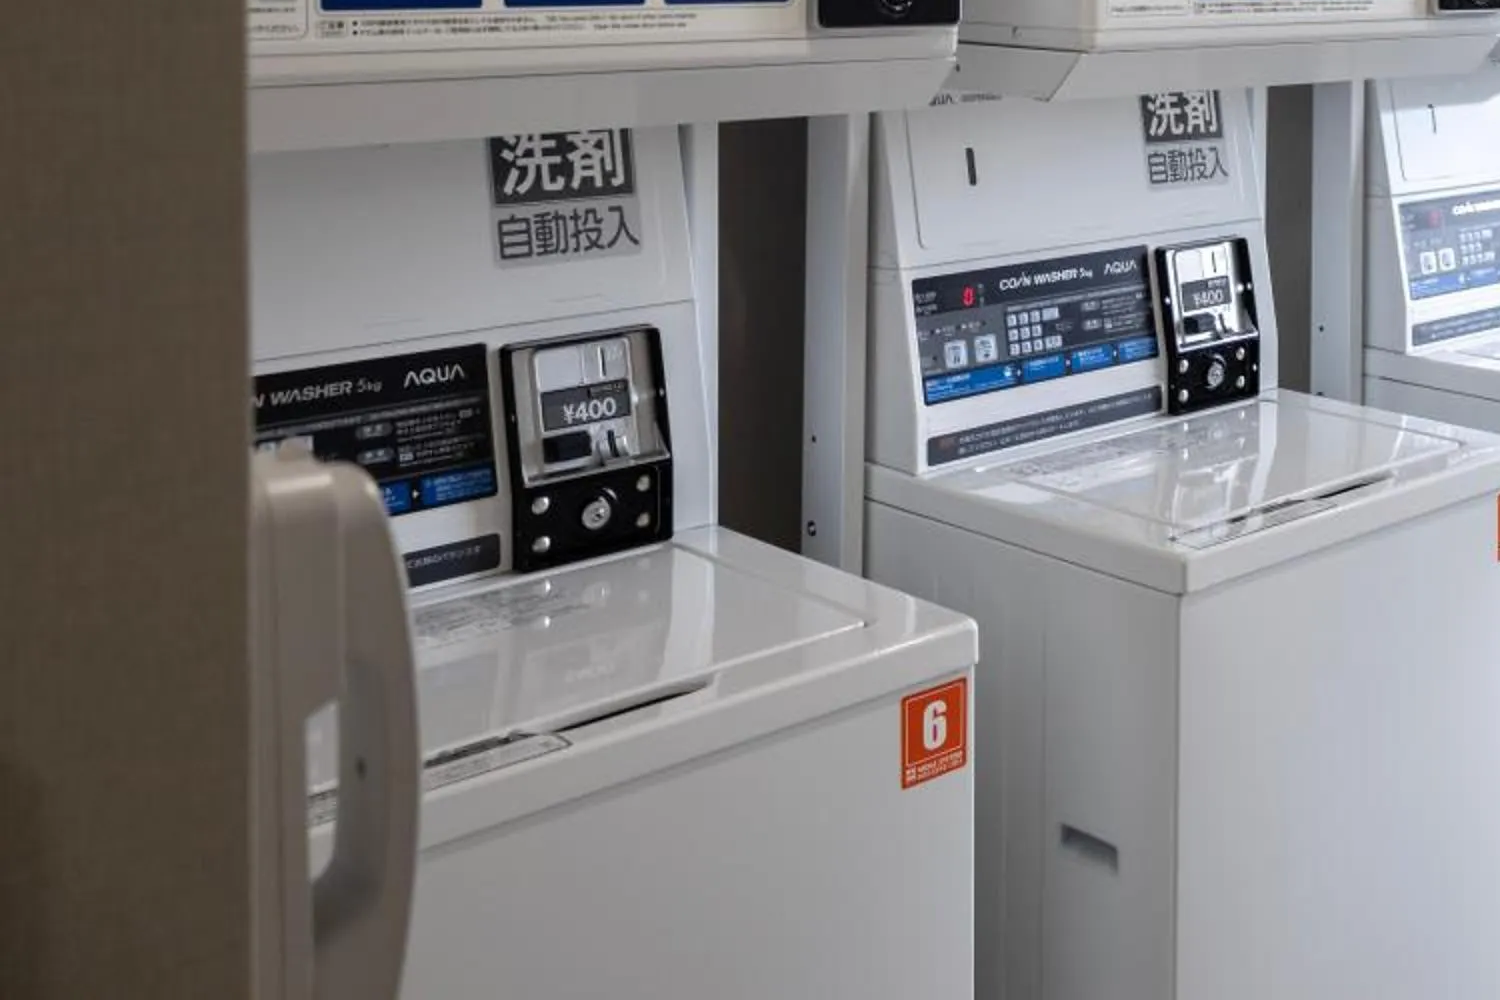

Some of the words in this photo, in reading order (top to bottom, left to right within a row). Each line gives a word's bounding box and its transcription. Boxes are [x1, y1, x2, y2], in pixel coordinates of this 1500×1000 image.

[1147, 90, 1217, 136] 洗剤
[500, 129, 626, 195] 洗剤
[1147, 146, 1229, 184] 自動投入
[497, 205, 640, 260] 自動投入
[1103, 259, 1138, 275] AQUA
[270, 380, 354, 408] WASHER
[403, 363, 467, 389] AQUA
[563, 396, 618, 425] ¥400
[922, 699, 947, 752] 6
